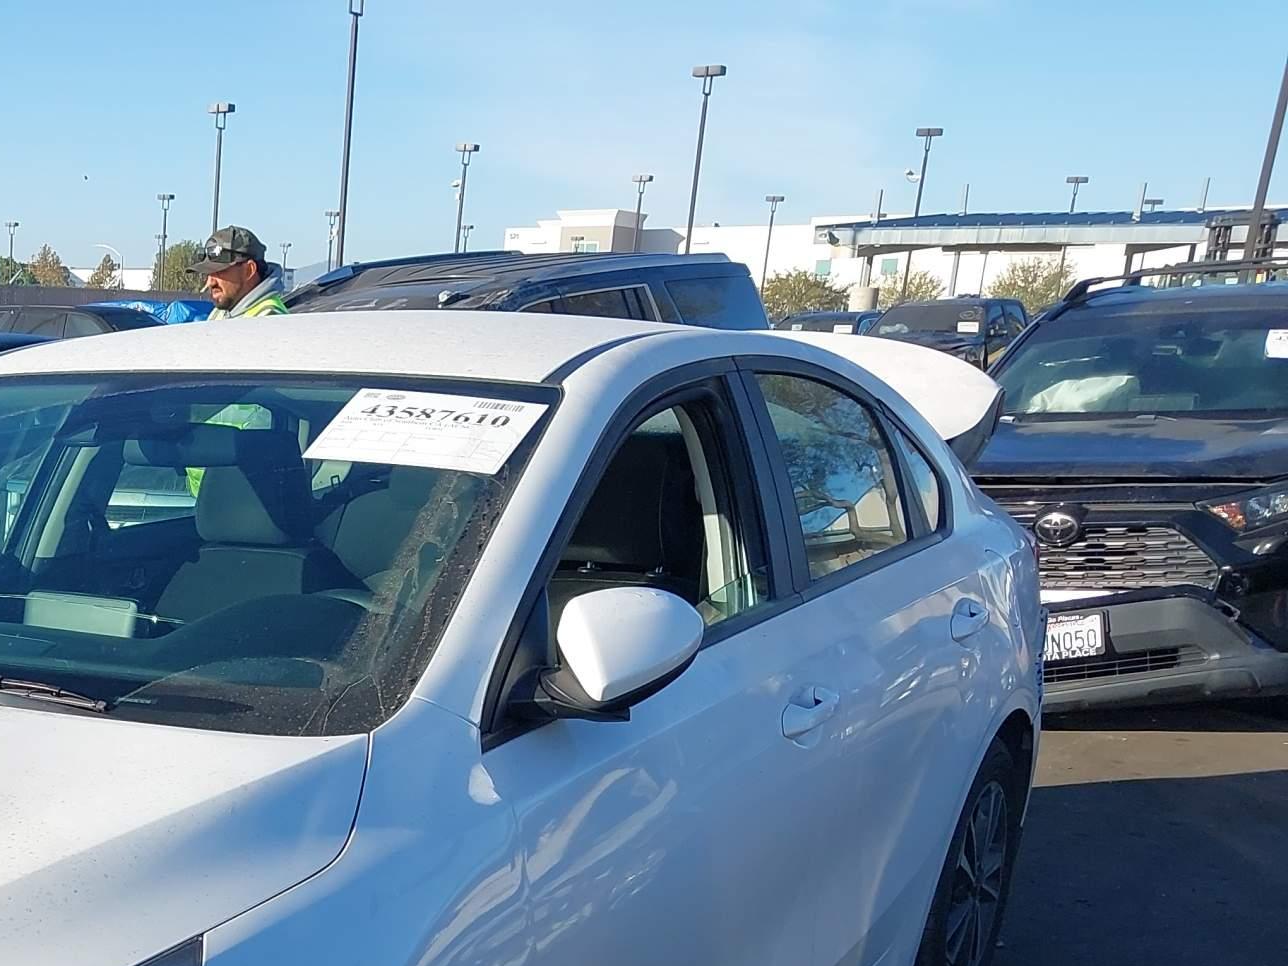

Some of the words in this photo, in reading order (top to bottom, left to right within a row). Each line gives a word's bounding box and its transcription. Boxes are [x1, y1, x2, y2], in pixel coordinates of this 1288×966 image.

[360, 403, 511, 428] 43587610
[1046, 629, 1097, 653] N050
[1061, 647, 1097, 660] PLACE
